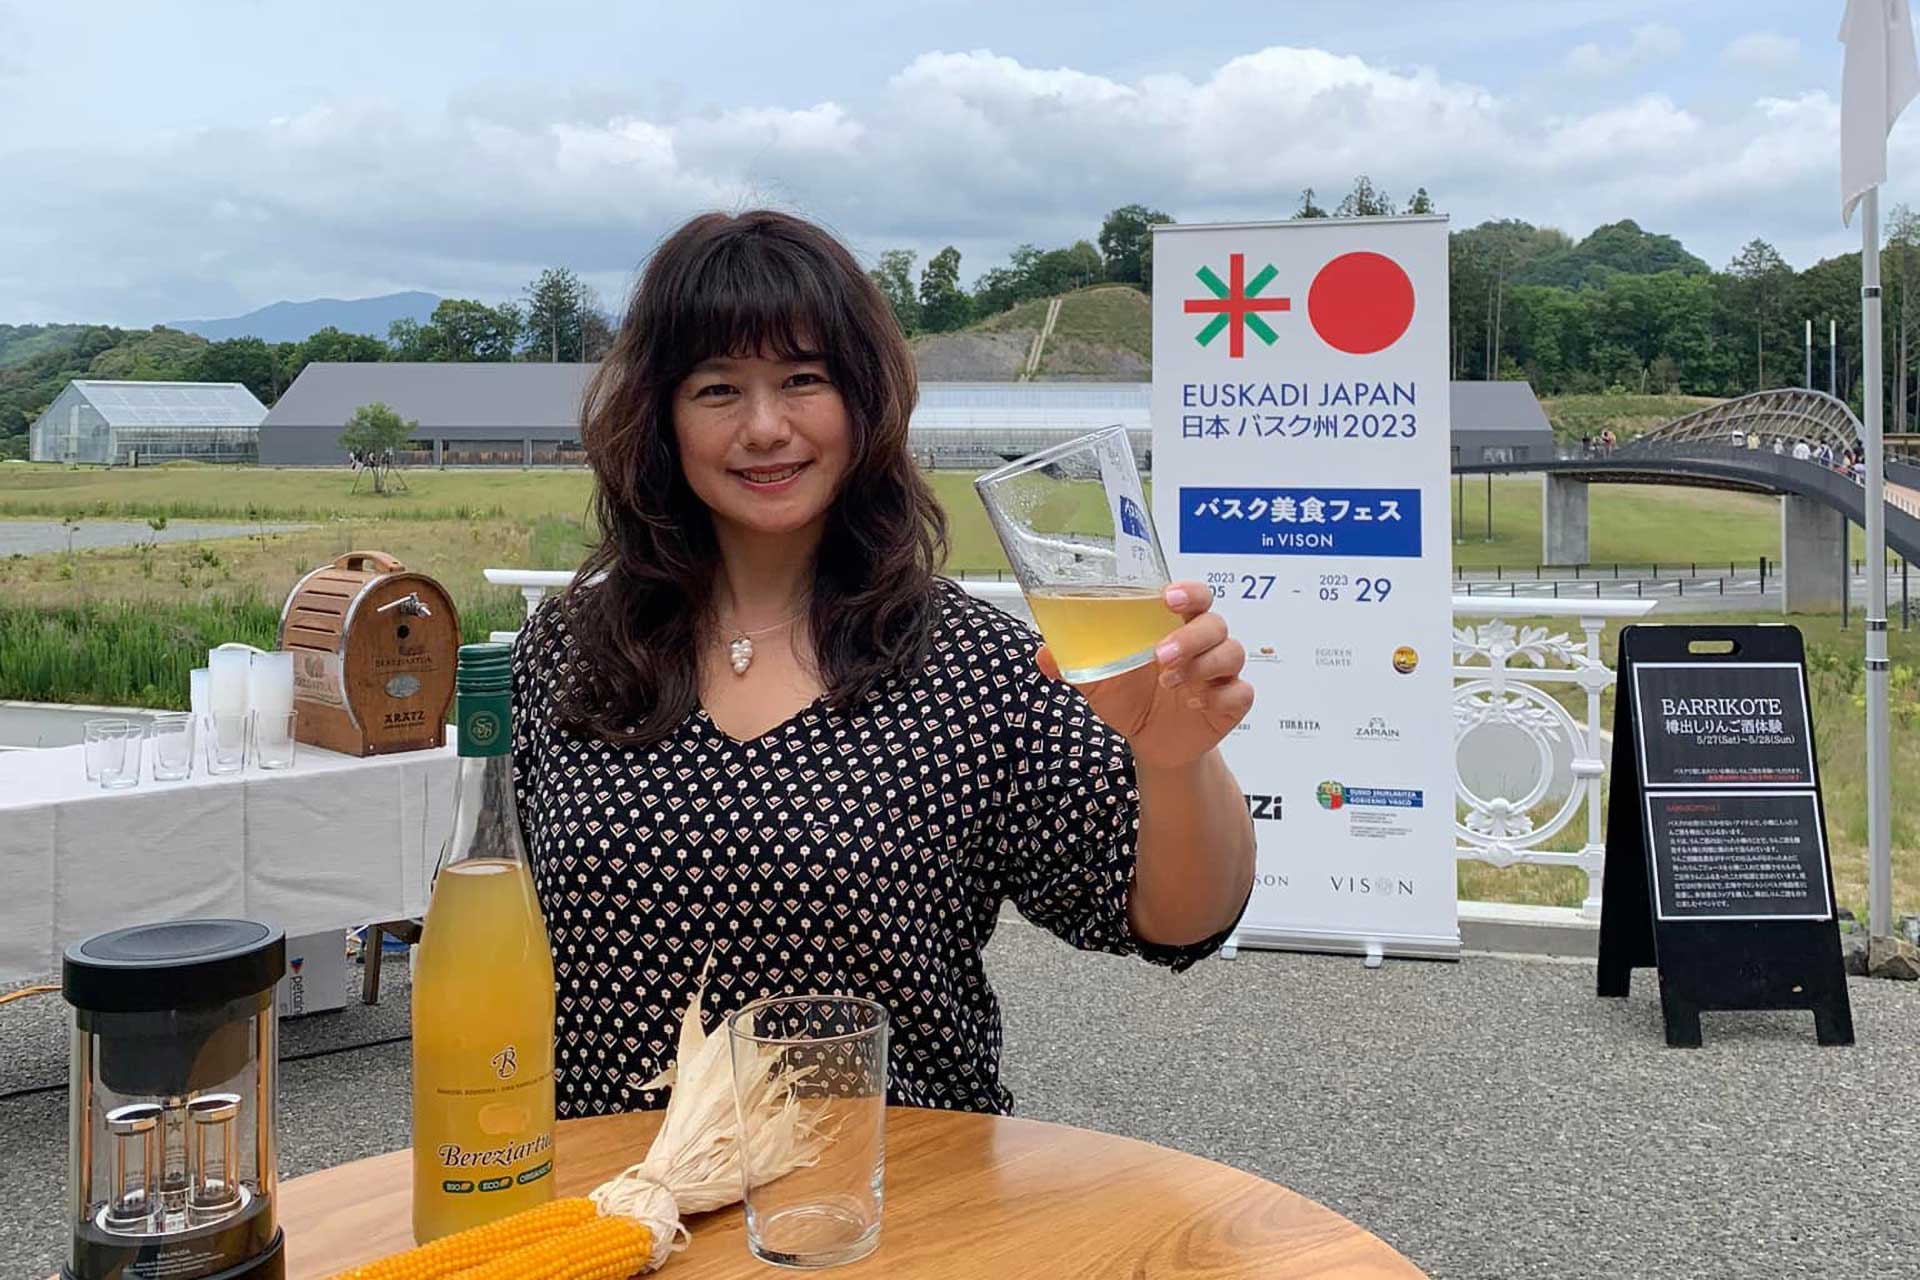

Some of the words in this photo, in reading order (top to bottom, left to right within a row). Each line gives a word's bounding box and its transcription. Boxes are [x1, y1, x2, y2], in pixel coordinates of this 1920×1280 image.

[1183, 383, 1308, 408] EUSKADI
[1318, 382, 1417, 407] JAPAN
[1182, 414, 1230, 439] 日本
[1194, 496, 1403, 524] バスク美食フェス
[1262, 533, 1274, 547] in
[1277, 533, 1334, 548] VISON
[1207, 572, 1235, 583] 2023
[1319, 575, 1349, 586] 2023
[1240, 575, 1277, 600] 27
[1354, 577, 1392, 602] 29
[1319, 588, 1339, 601] 05
[1661, 698, 1783, 716] BARRIKOTE
[1355, 727, 1400, 737] ZAPIAIN
[1665, 719, 1784, 735] 樽出しりんご酒体験
[438, 1134, 552, 1167] Bereziartu
